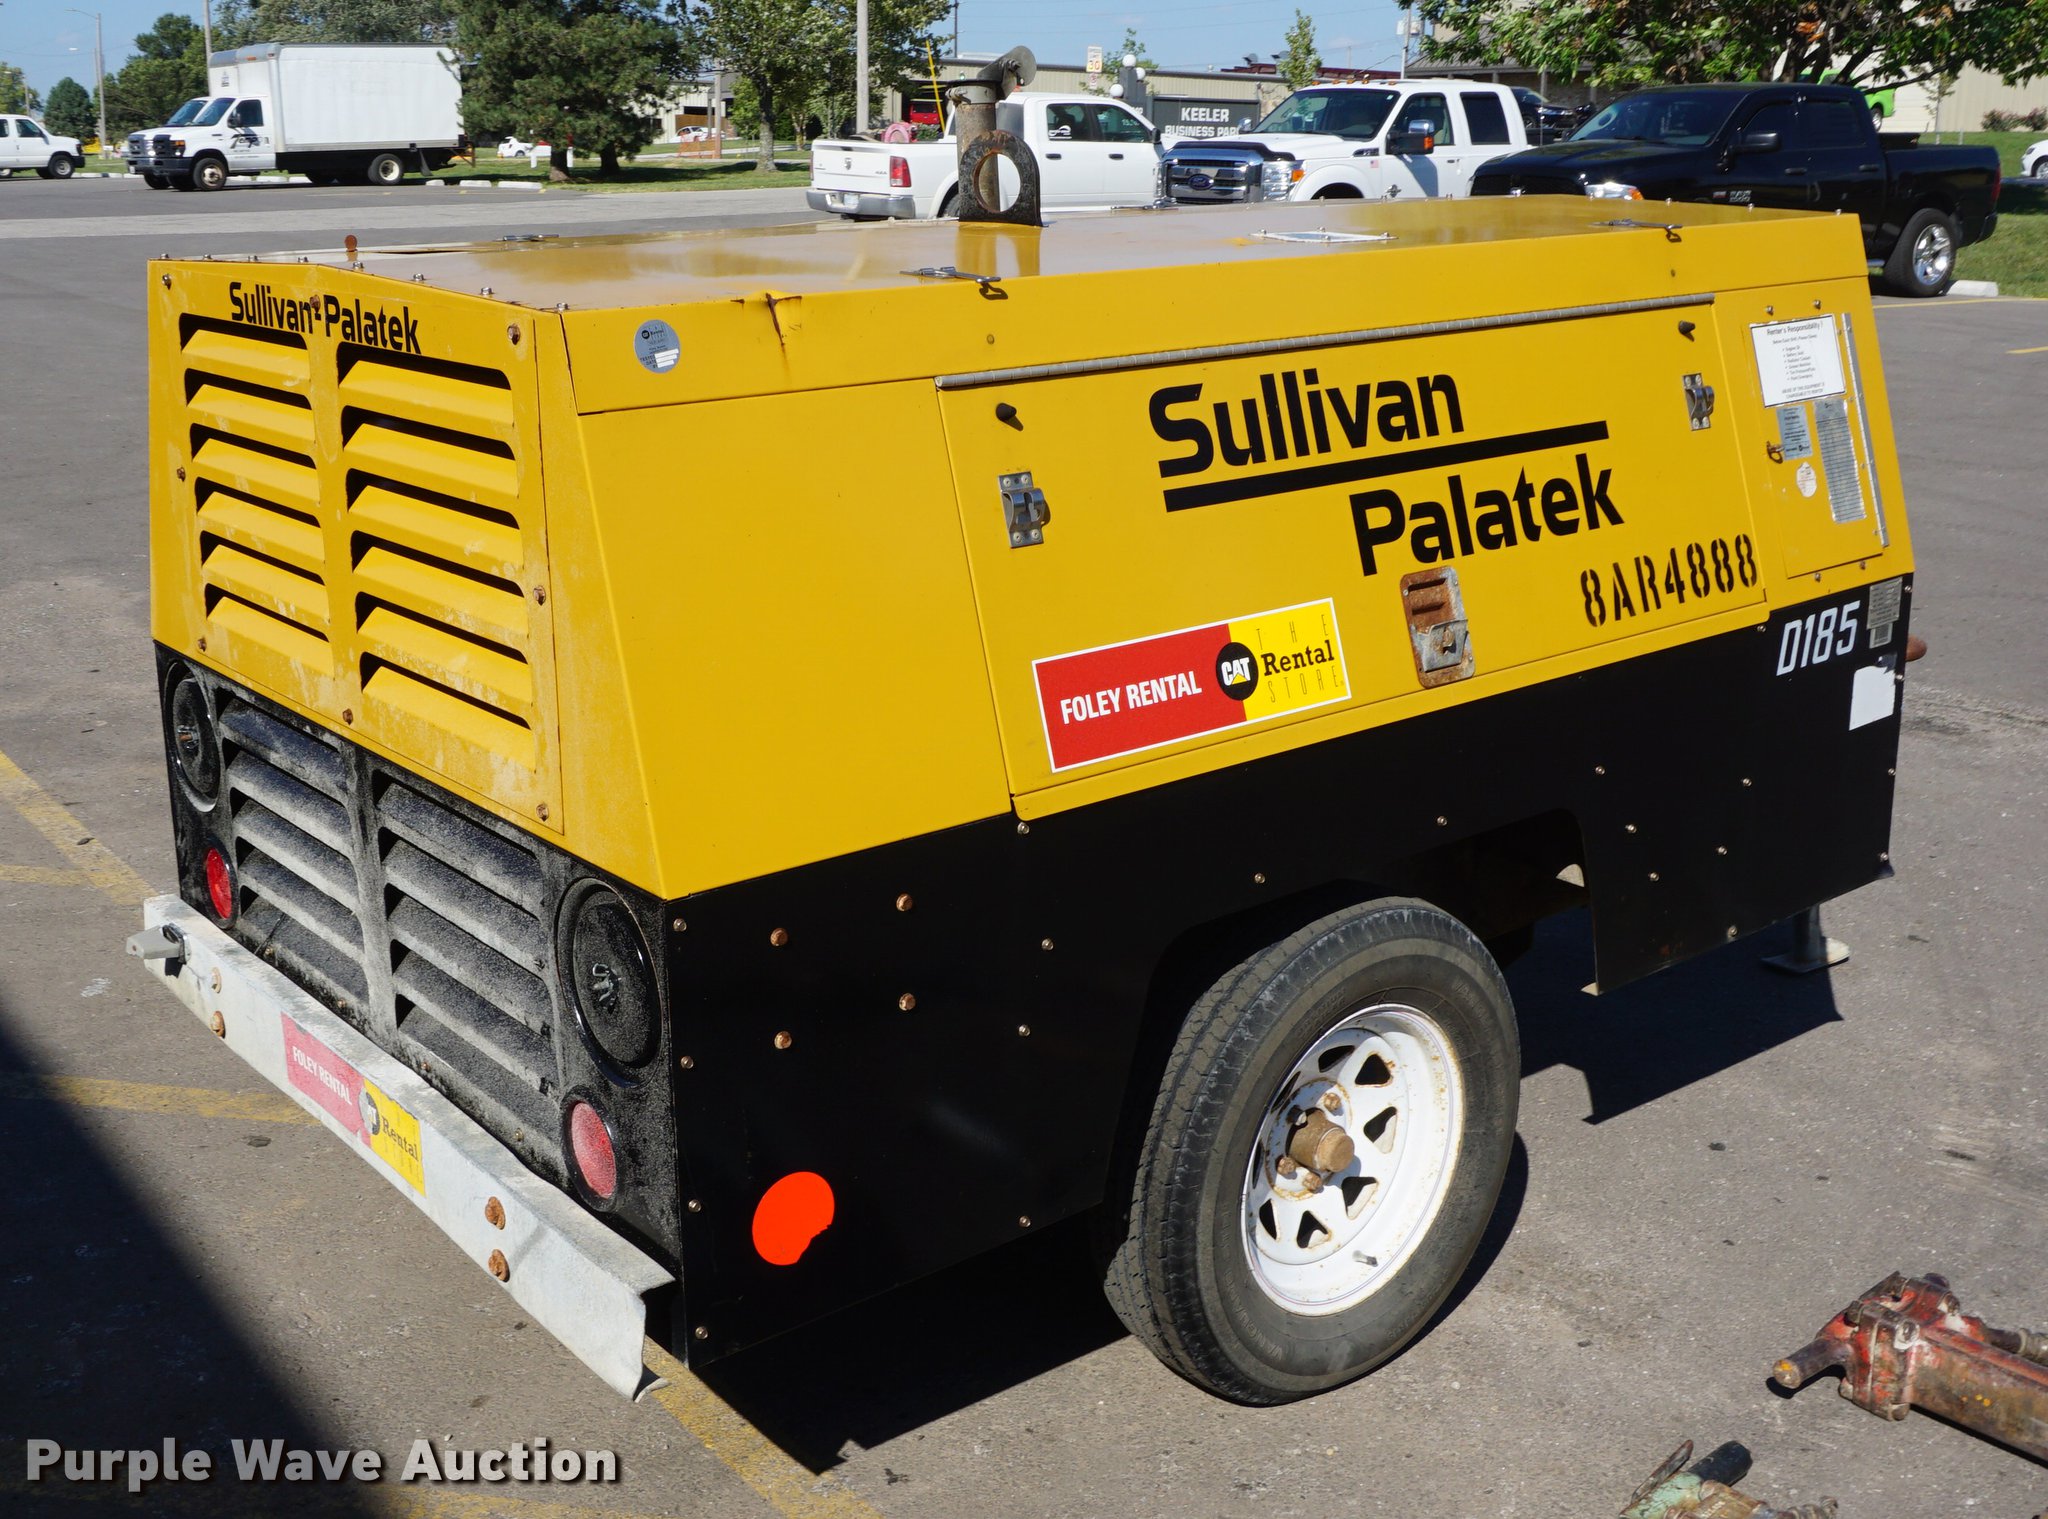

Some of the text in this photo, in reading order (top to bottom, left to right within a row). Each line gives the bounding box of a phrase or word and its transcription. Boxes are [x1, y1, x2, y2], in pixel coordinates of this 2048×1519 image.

[1164, 125, 1240, 137] BUSINESS PAR
[1181, 107, 1230, 122] KEELER
[1148, 367, 1465, 479] Sullivan
[1349, 453, 1625, 577] Palatek
[1580, 533, 1758, 628] 8AR4888
[1260, 639, 1335, 677] Rental
[1776, 600, 1861, 677] D185
[1060, 670, 1202, 725] FOLEY RENTAL
[1221, 656, 1251, 686] CAT
[291, 1045, 353, 1106] FOLEY RENTAL
[381, 1114, 420, 1162] Rental
